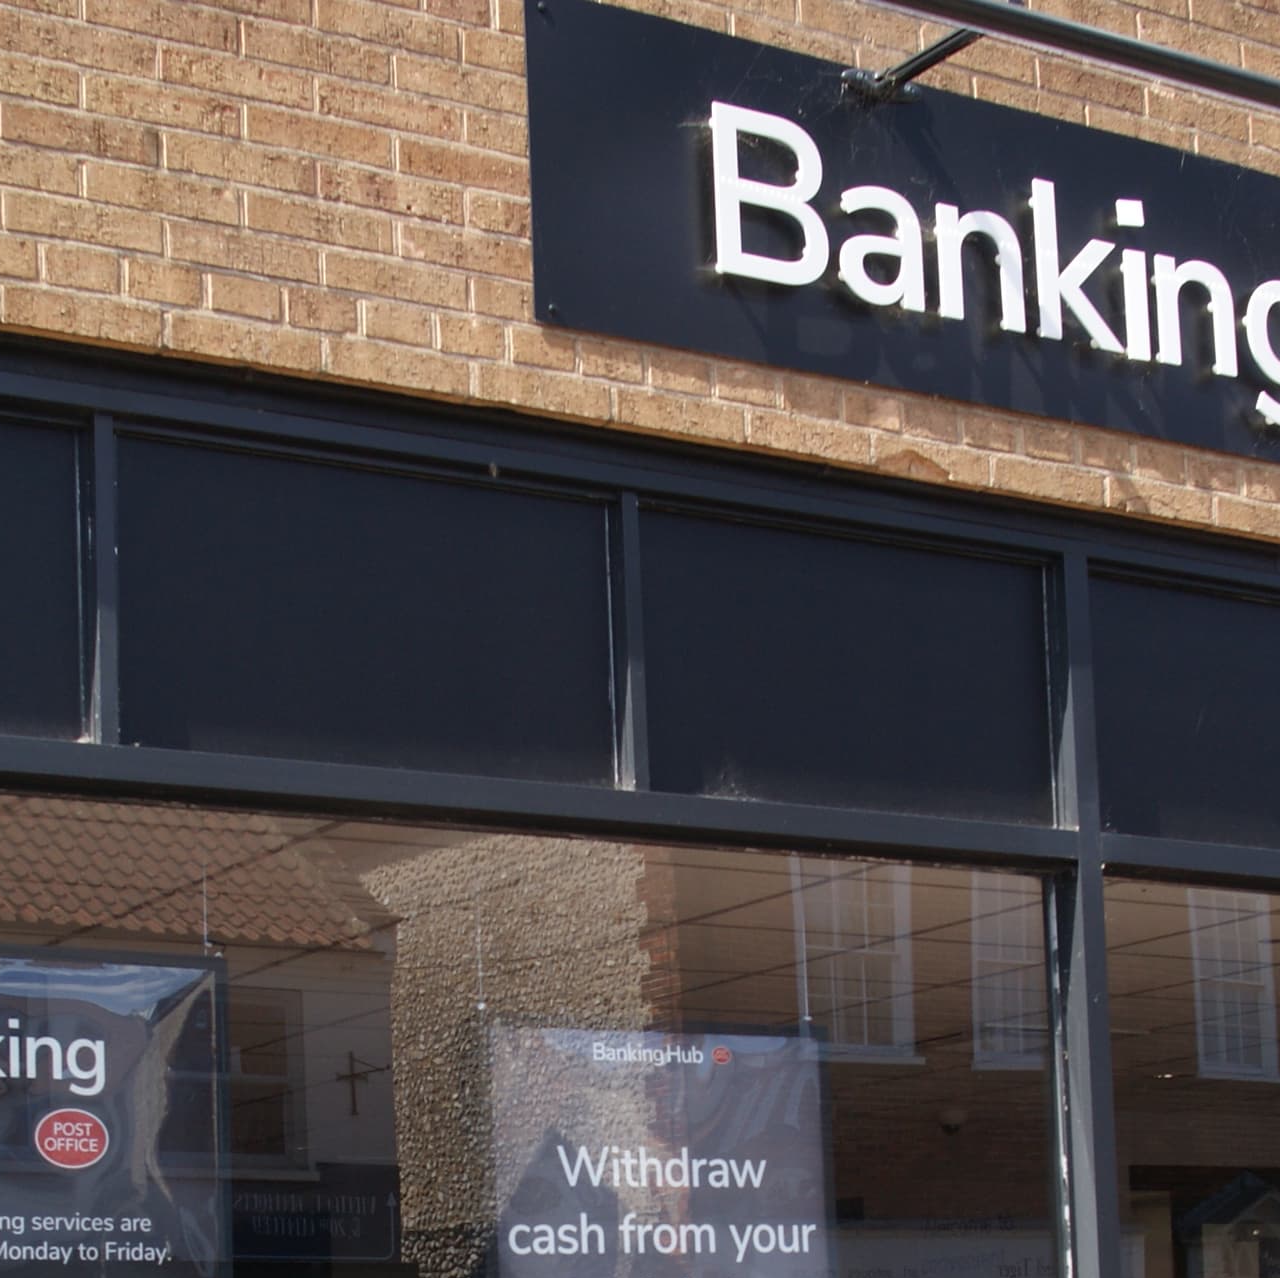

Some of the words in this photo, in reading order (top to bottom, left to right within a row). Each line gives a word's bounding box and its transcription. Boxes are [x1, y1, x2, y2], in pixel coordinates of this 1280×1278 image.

[53, 1121, 93, 1137] POST
[44, 1136, 98, 1153] OFFICE
[557, 1144, 766, 1189] Withdraw
[31, 1214, 114, 1233] services
[120, 1218, 152, 1233] are
[508, 1214, 605, 1256] cash
[618, 1217, 716, 1255] from
[729, 1222, 817, 1262] your
[79, 1244, 98, 1261] to
[104, 1242, 172, 1265] Friday.
